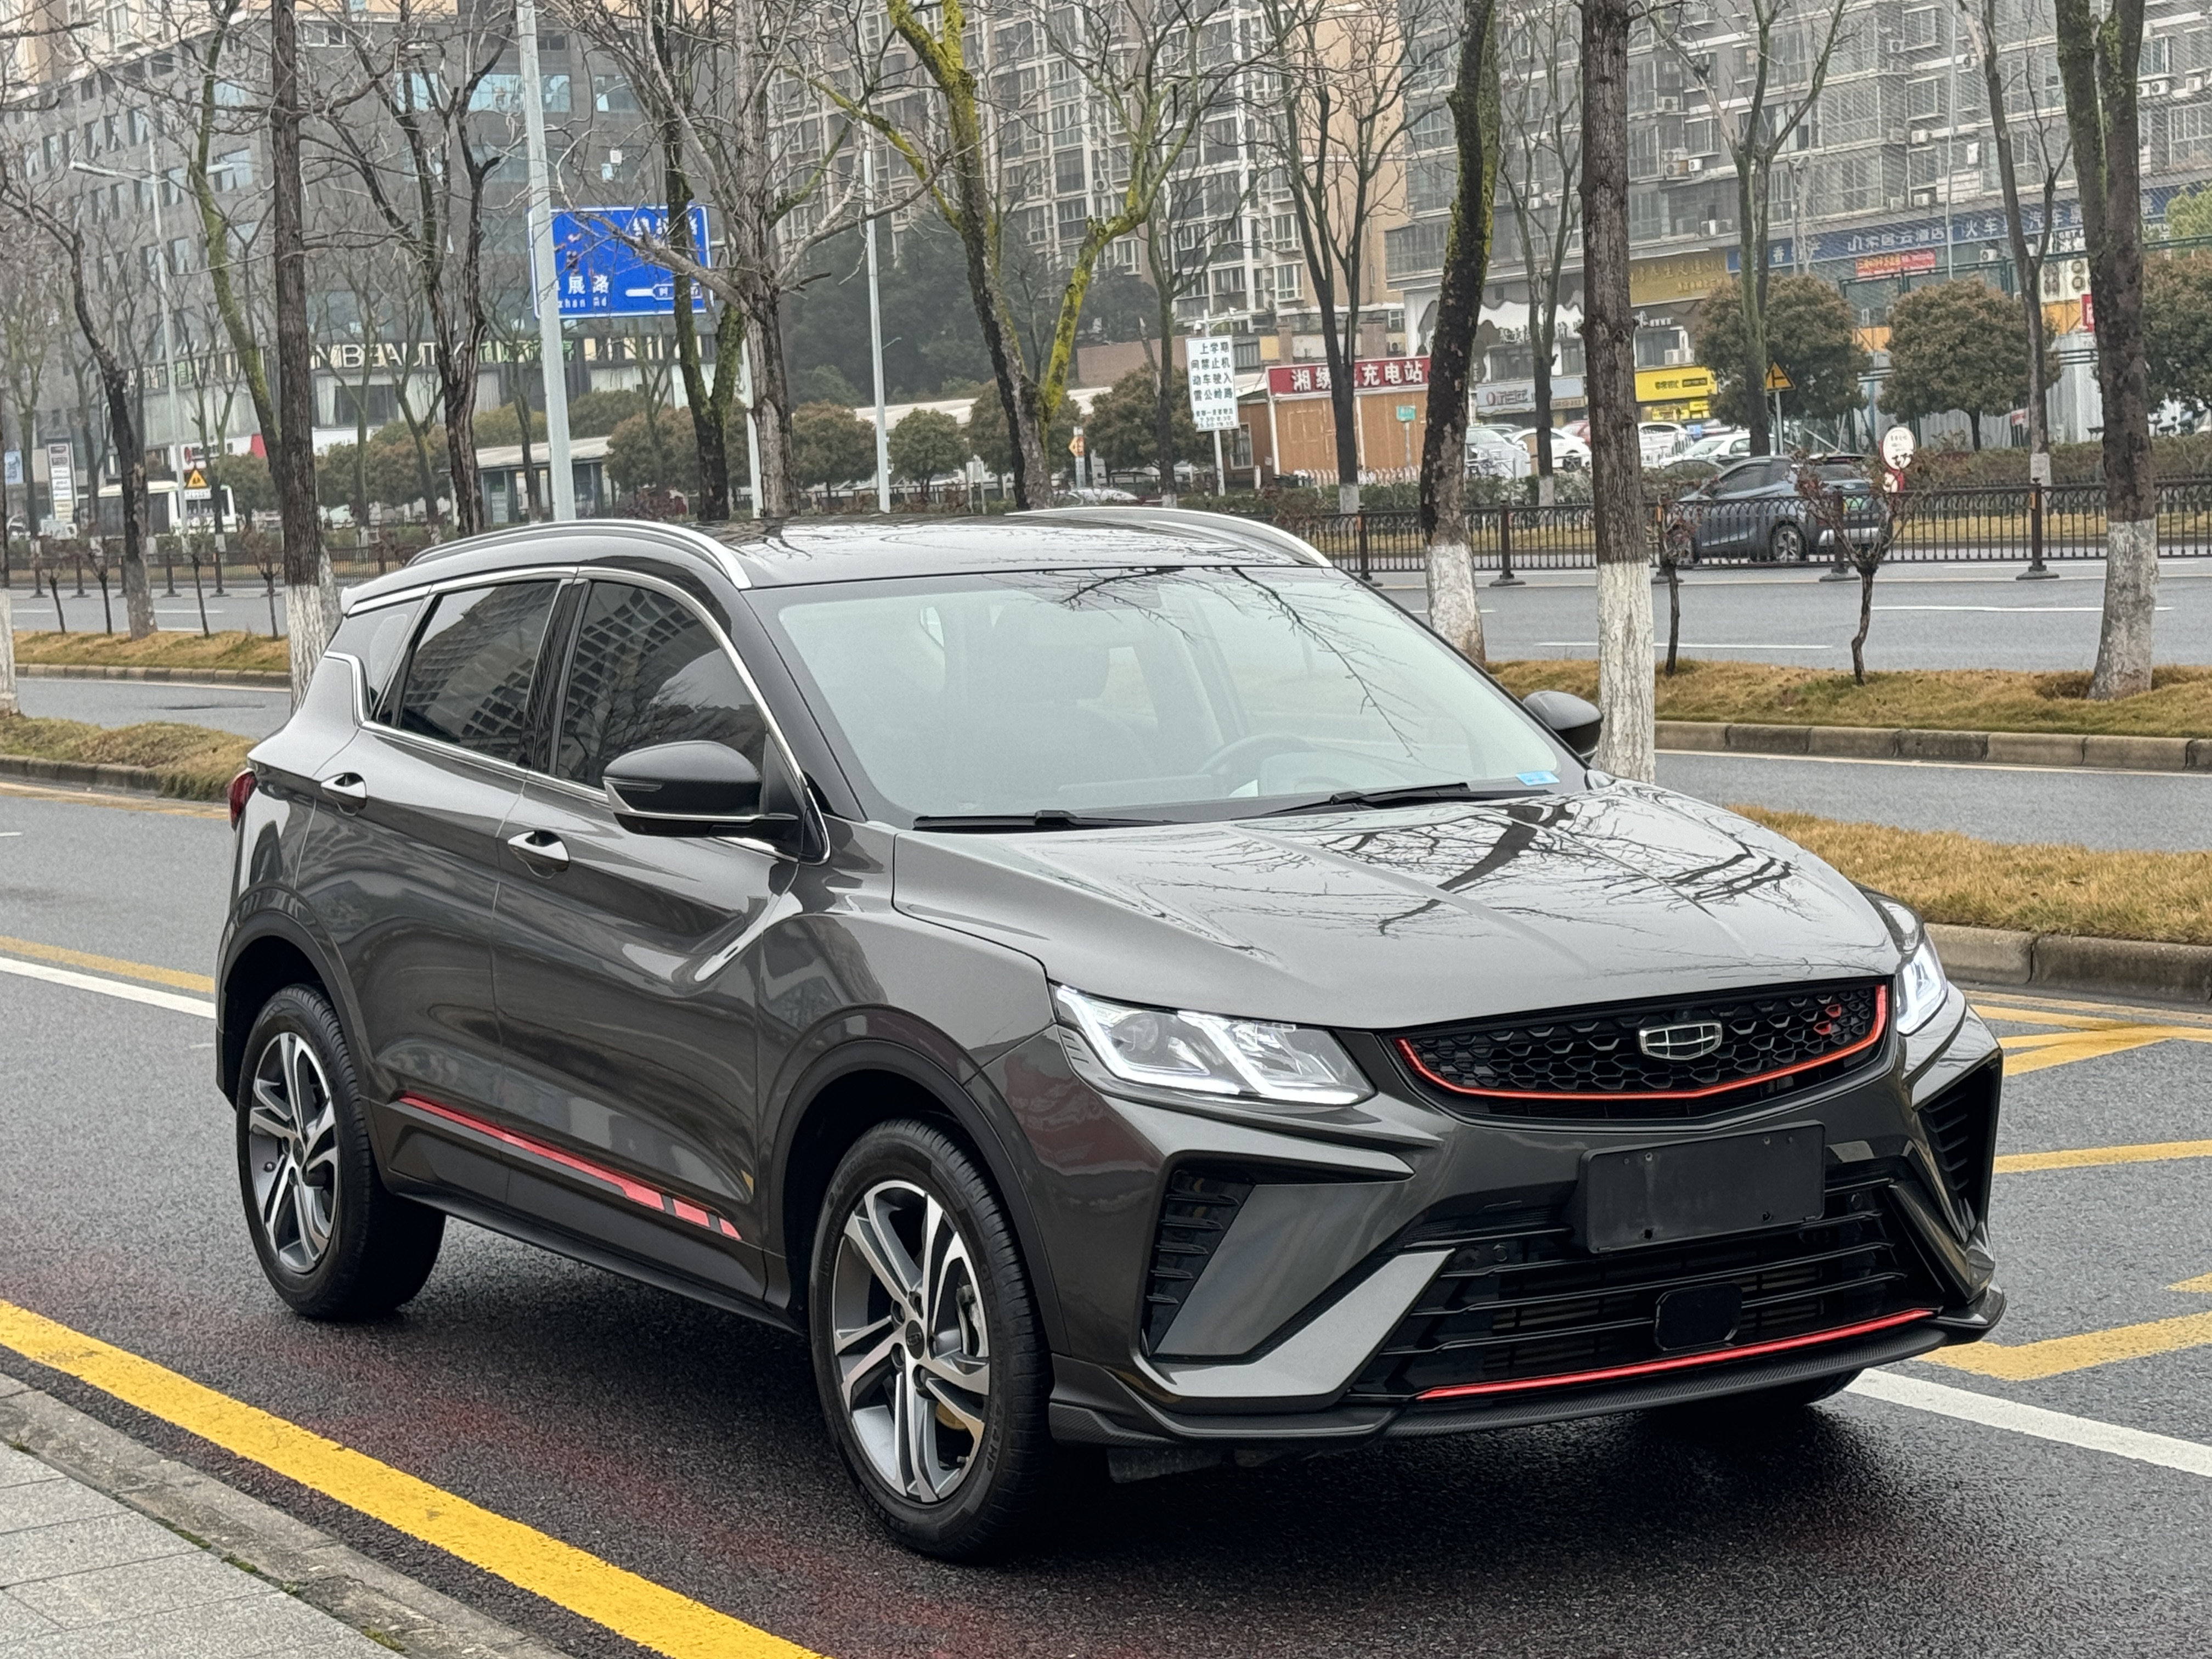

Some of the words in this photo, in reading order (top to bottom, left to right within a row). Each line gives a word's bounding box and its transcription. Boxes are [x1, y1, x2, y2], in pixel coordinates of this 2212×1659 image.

[555, 274, 610, 295] 展路
[1291, 360, 1424, 391] 湘绣充电站
